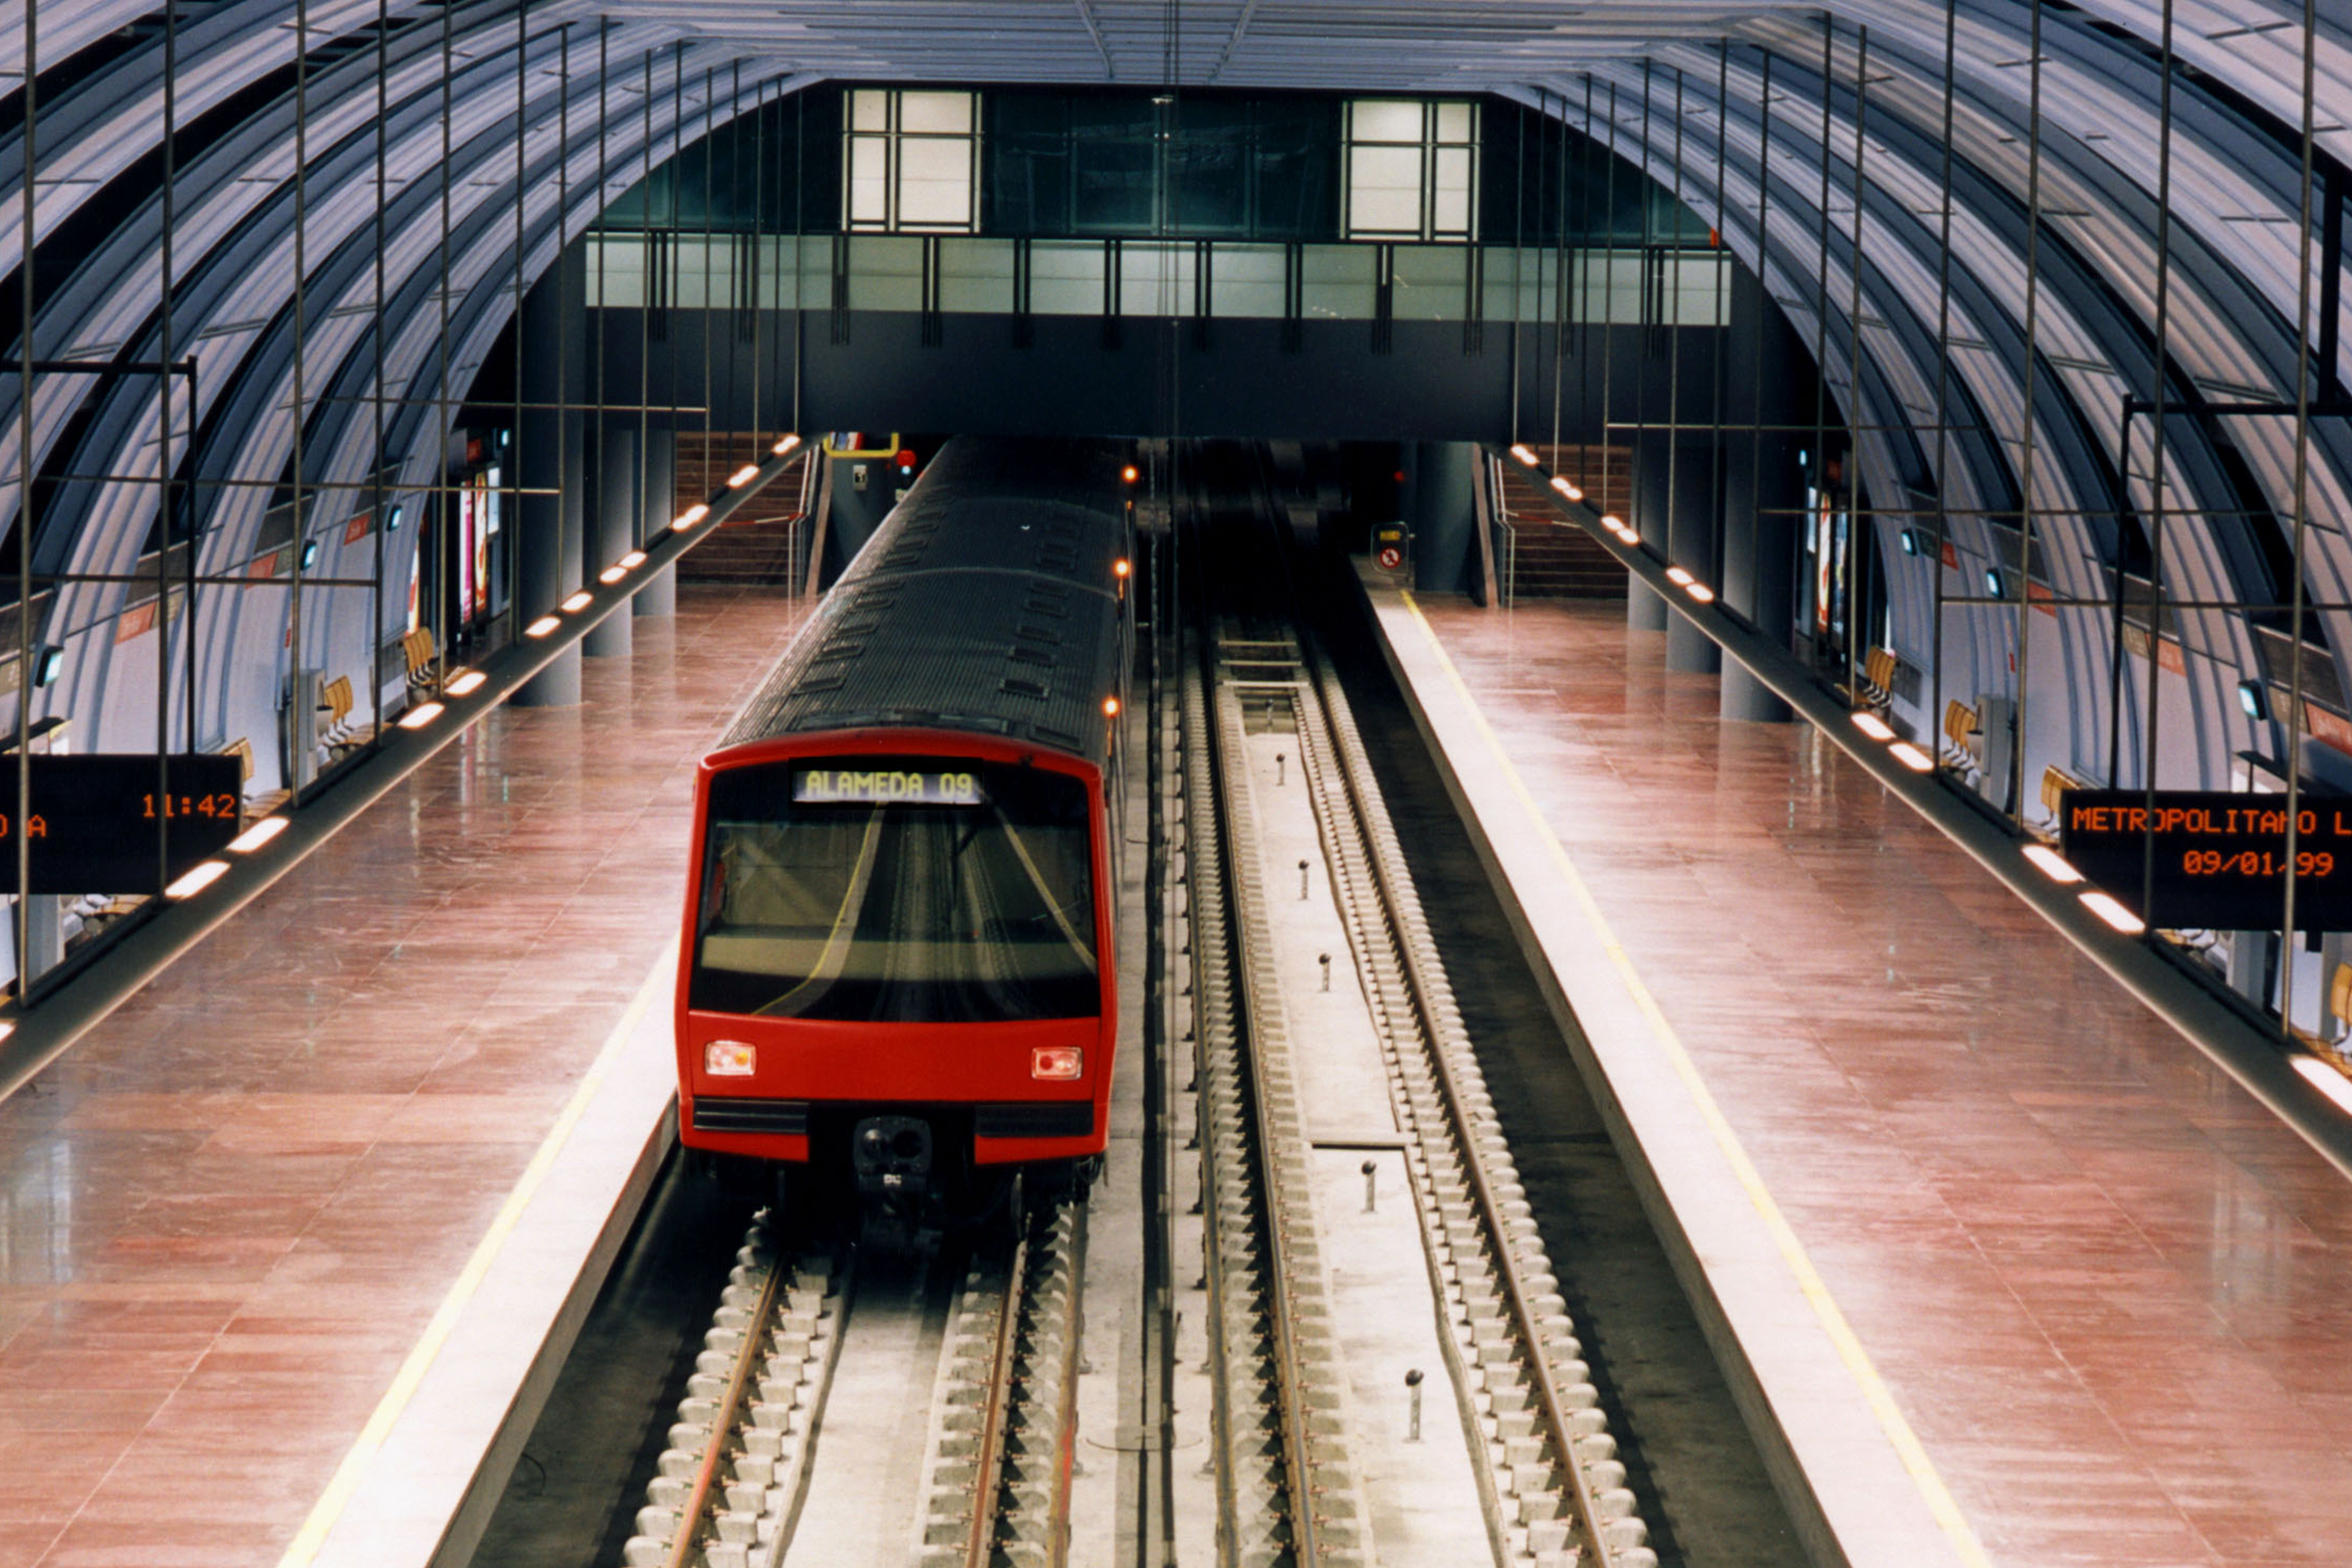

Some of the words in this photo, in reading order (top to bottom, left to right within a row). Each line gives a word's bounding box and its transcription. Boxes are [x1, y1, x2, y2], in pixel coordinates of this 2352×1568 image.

[806, 771, 924, 799] ALAMEDA
[939, 773, 973, 799] 09
[142, 793, 236, 818] 11:42
